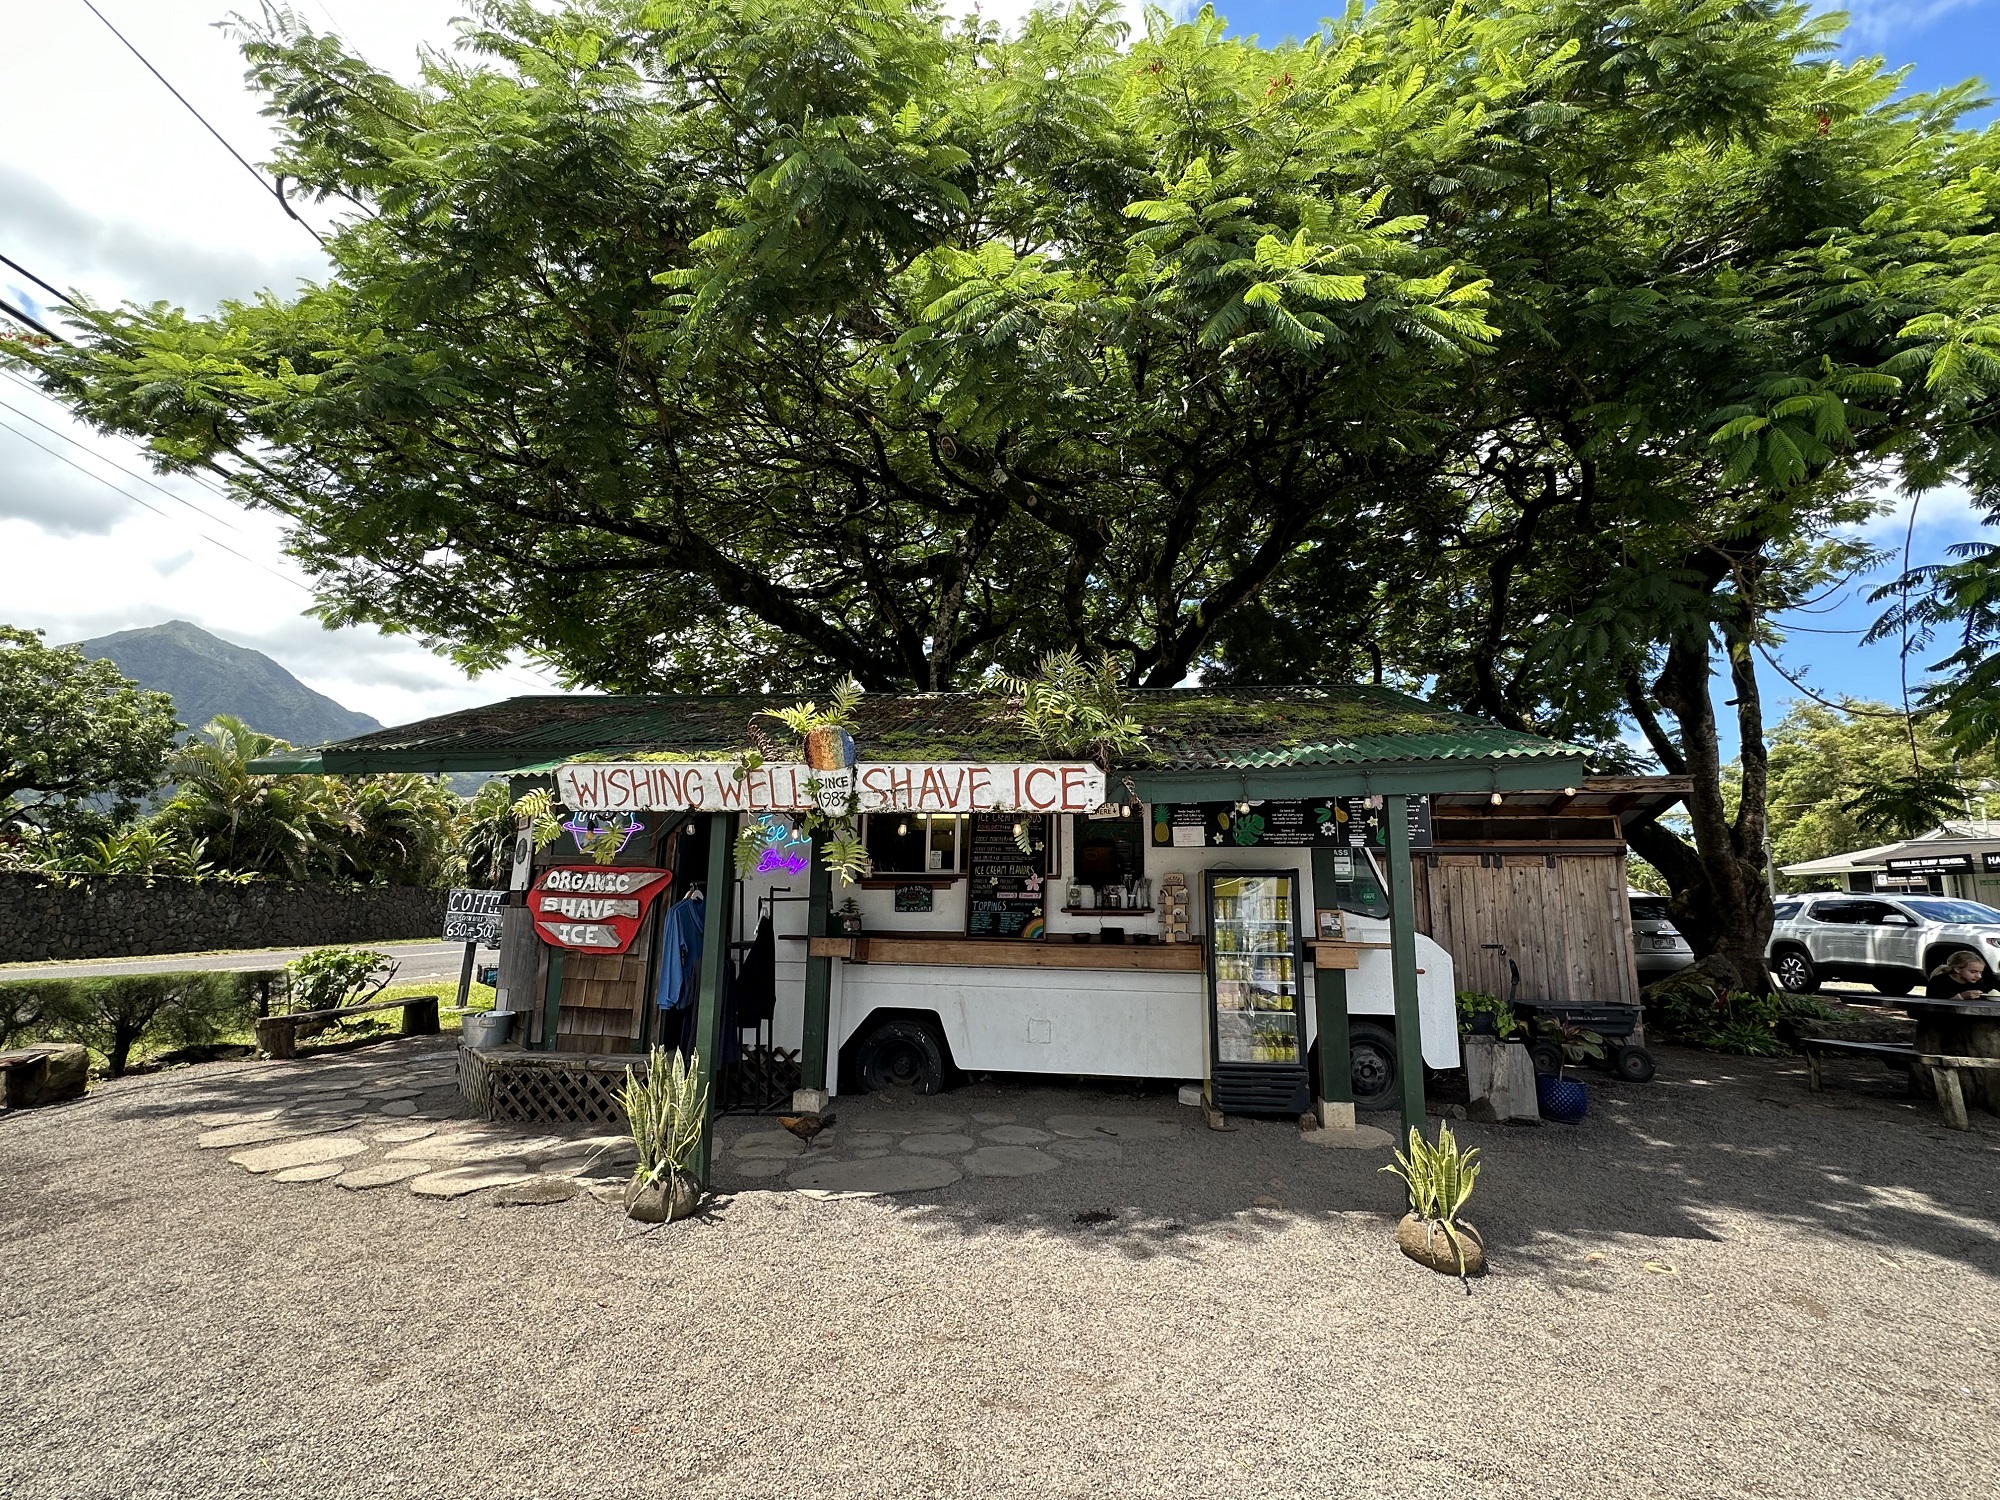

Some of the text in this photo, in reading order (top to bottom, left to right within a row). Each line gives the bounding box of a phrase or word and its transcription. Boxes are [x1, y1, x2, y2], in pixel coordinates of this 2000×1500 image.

[569, 768, 813, 809] WISHING WELL
[817, 775, 849, 789] SINCE
[862, 766, 1088, 810] SHAVE ICE
[818, 791, 846, 807] 1983
[757, 849, 808, 875] Baby
[975, 865, 1035, 876] ICE CREAM FLAVORS
[546, 870, 630, 892] ORGANIC
[543, 897, 617, 918] SHAVE
[972, 900, 1007, 912] TOPPINGS
[558, 924, 599, 944] ICE
